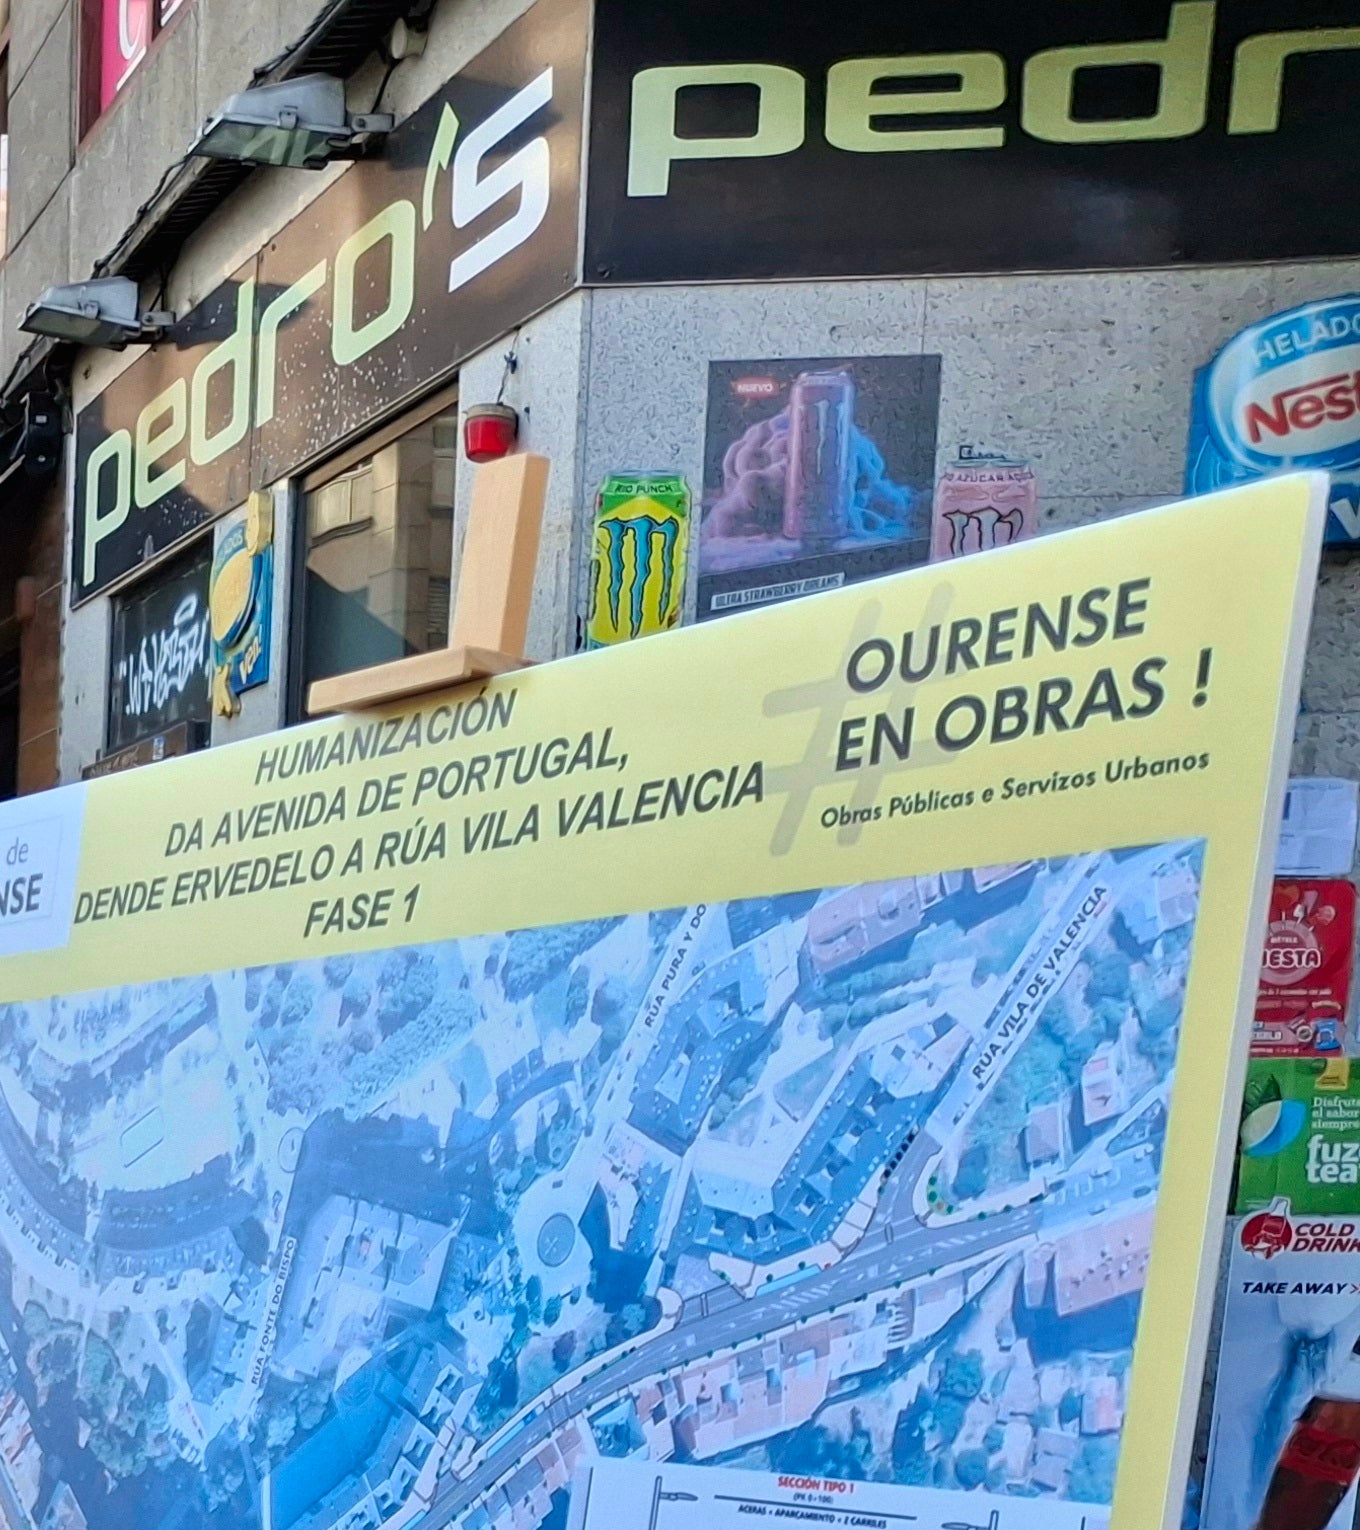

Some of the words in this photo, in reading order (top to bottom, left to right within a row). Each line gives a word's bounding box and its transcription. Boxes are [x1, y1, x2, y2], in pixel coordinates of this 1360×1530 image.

[737, 382, 773, 393] NUEVO
[636, 484, 673, 494] PUNCH
[846, 577, 1151, 693] OURENSE
[835, 707, 915, 772] EN
[934, 656, 1168, 753] OBRAS
[1192, 647, 1213, 708] !
[255, 688, 517, 785] HUMANIZACIÓN
[166, 818, 205, 857] DA
[211, 788, 347, 848] AVENIDA
[356, 777, 403, 818] DE
[413, 727, 630, 806] PORTUGAL,
[821, 801, 882, 828] Obras
[889, 788, 975, 818] Públicas
[981, 787, 994, 803] e
[1001, 770, 1097, 801] Servizos
[1104, 752, 1210, 784] Urbanos
[6, 837, 29, 866] de
[74, 876, 168, 924] DENDE
[171, 844, 335, 908] ERVEDELO
[340, 843, 365, 878] A
[374, 817, 448, 868] RÚA
[460, 804, 541, 854] VILA
[557, 761, 766, 837] VALENCIA
[303, 891, 394, 938] FASE
[406, 884, 421, 923] 1
[644, 995, 665, 1028] RUA
[661, 948, 687, 991] PURA
[683, 931, 692, 941] Y
[690, 904, 706, 929] DO
[1262, 949, 1320, 968] IESTA
[972, 1043, 1002, 1078] RUA
[998, 1001, 1030, 1038] VILA
[1026, 973, 1046, 998] DE
[1043, 886, 1107, 971] VALENCIA
[1312, 1107, 1323, 1118] el
[1326, 1107, 1360, 1118] sabor
[1307, 1134, 1360, 1162] fuz
[1305, 1162, 1358, 1183] tea
[1295, 1223, 1355, 1237] COLD
[1242, 1282, 1288, 1294] TAKE
[1290, 1282, 1348, 1294] AWAY
[251, 1355, 264, 1385] RUA
[260, 1311, 276, 1352] FONTE
[272, 1284, 283, 1304] DO
[280, 1239, 294, 1279] BISPO
[778, 1475, 820, 1491] SECCIÓN
[823, 1480, 847, 1493] TIPO
[738, 1504, 766, 1516] ACERAS
[774, 1508, 836, 1523] APARCAMIENTO
[850, 1516, 887, 1529] CARRILES
